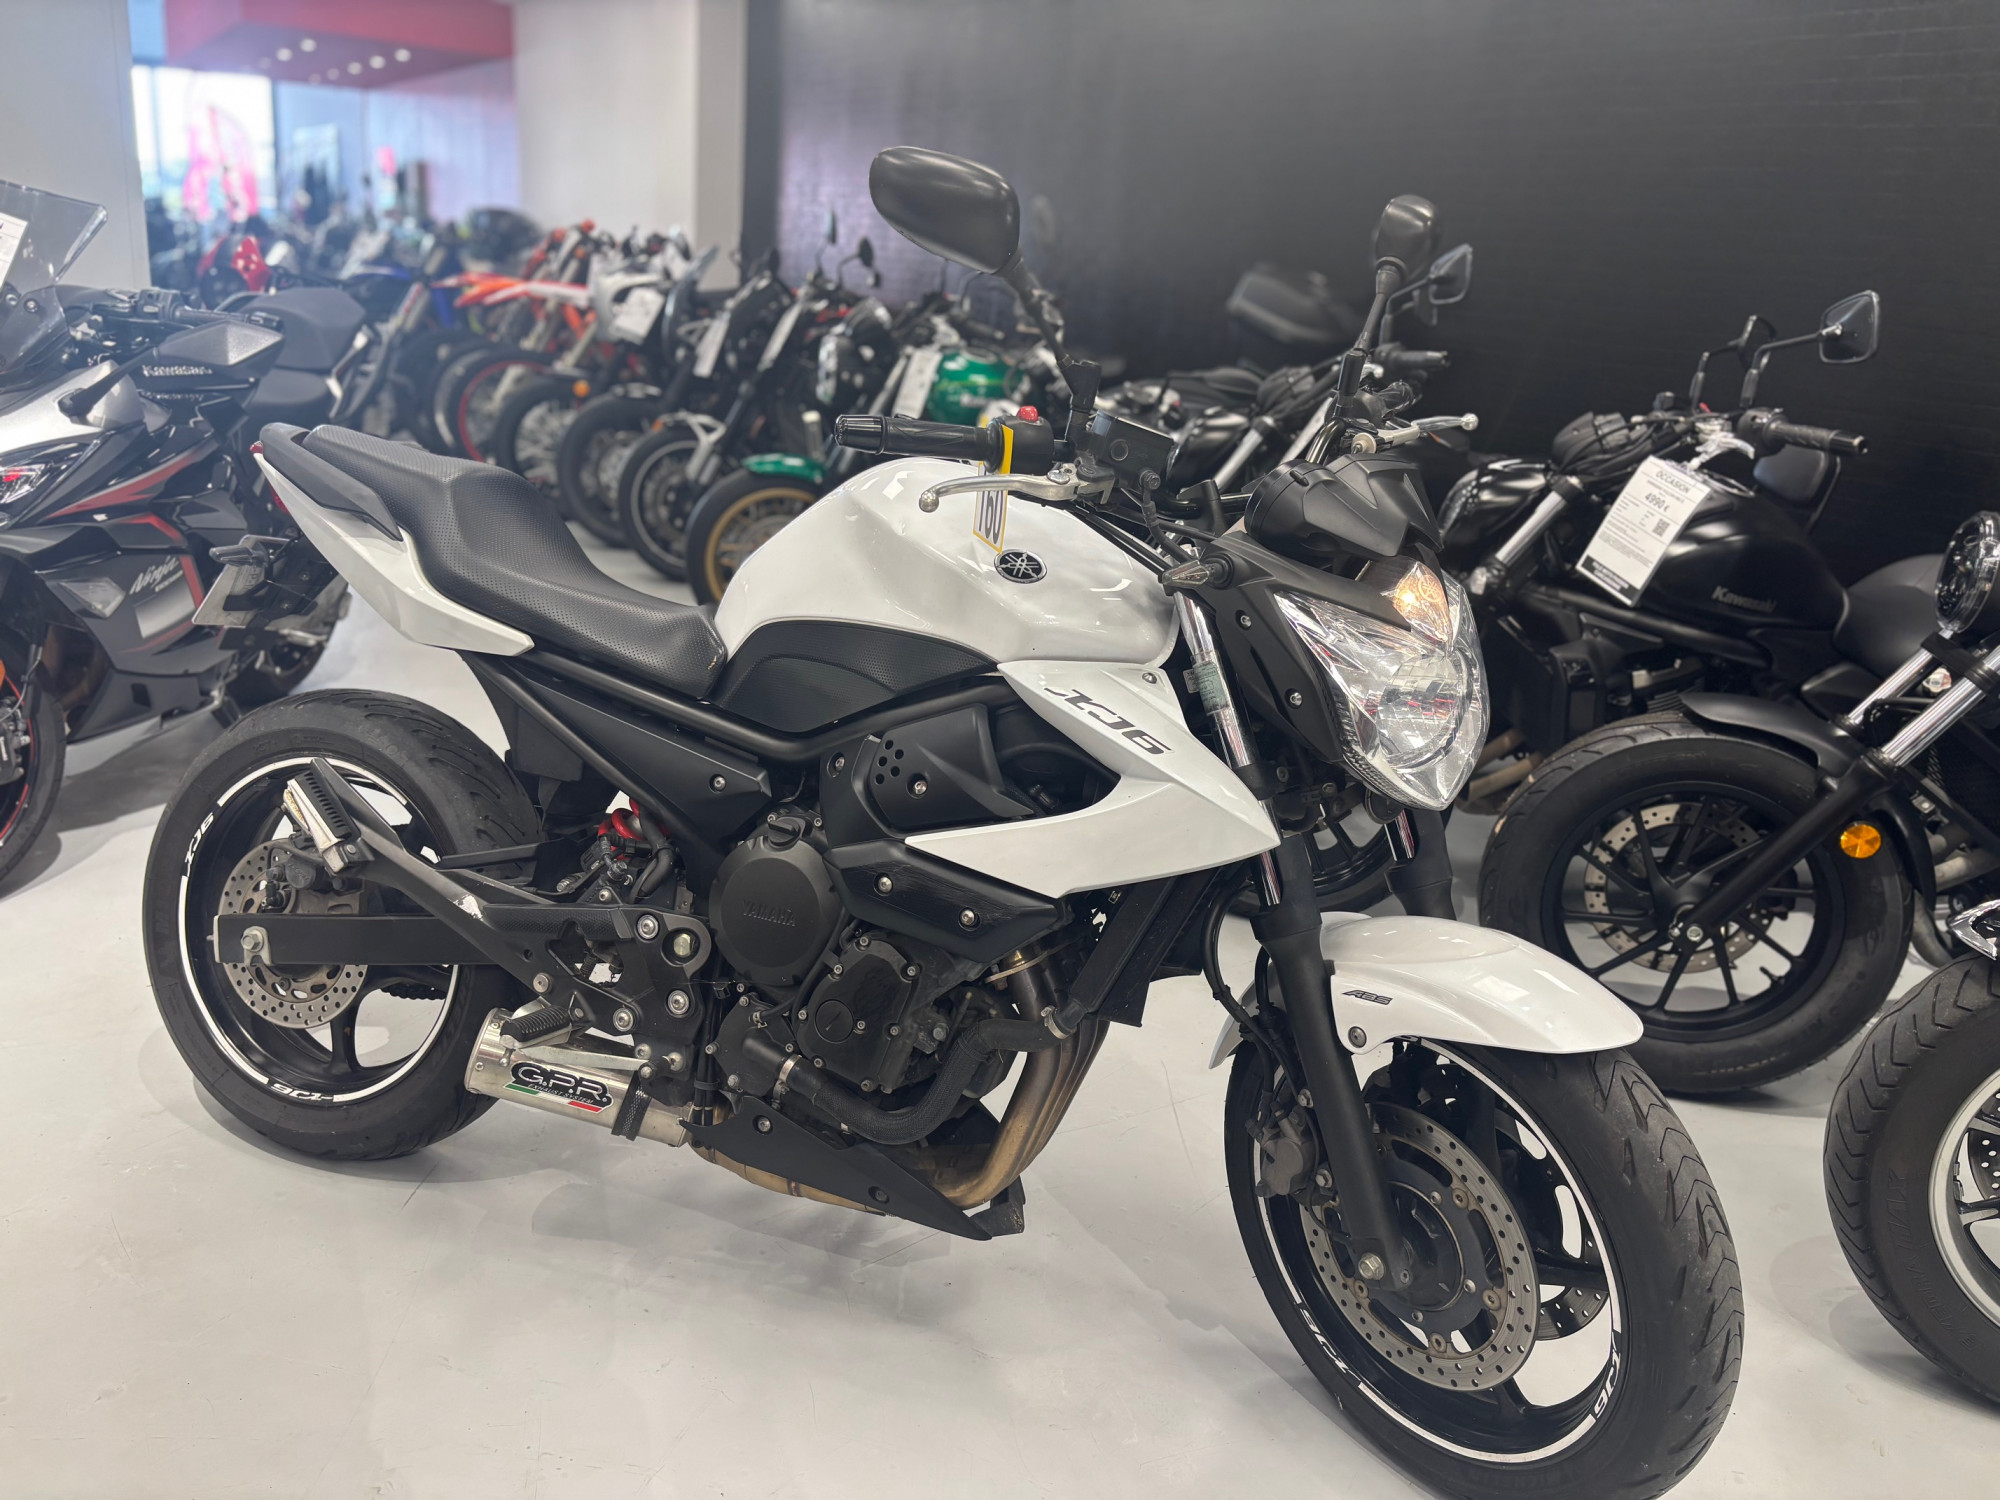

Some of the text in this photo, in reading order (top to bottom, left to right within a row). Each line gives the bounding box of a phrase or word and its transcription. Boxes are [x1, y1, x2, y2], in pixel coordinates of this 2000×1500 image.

[1655, 471, 1691, 494] OCCASION
[1644, 492, 1666, 510] 4990
[129, 554, 180, 595] Ninja
[1044, 687, 1172, 754] XJ6
[184, 811, 214, 878] XJ6
[742, 899, 797, 927] YAMAHA
[1341, 989, 1393, 1006] ABS
[271, 1083, 333, 1101] XJ6
[528, 1083, 595, 1104] EXHAUST SYSTEM
[1299, 1308, 1362, 1382] XJ6
[1591, 1331, 1621, 1420] XJ6
